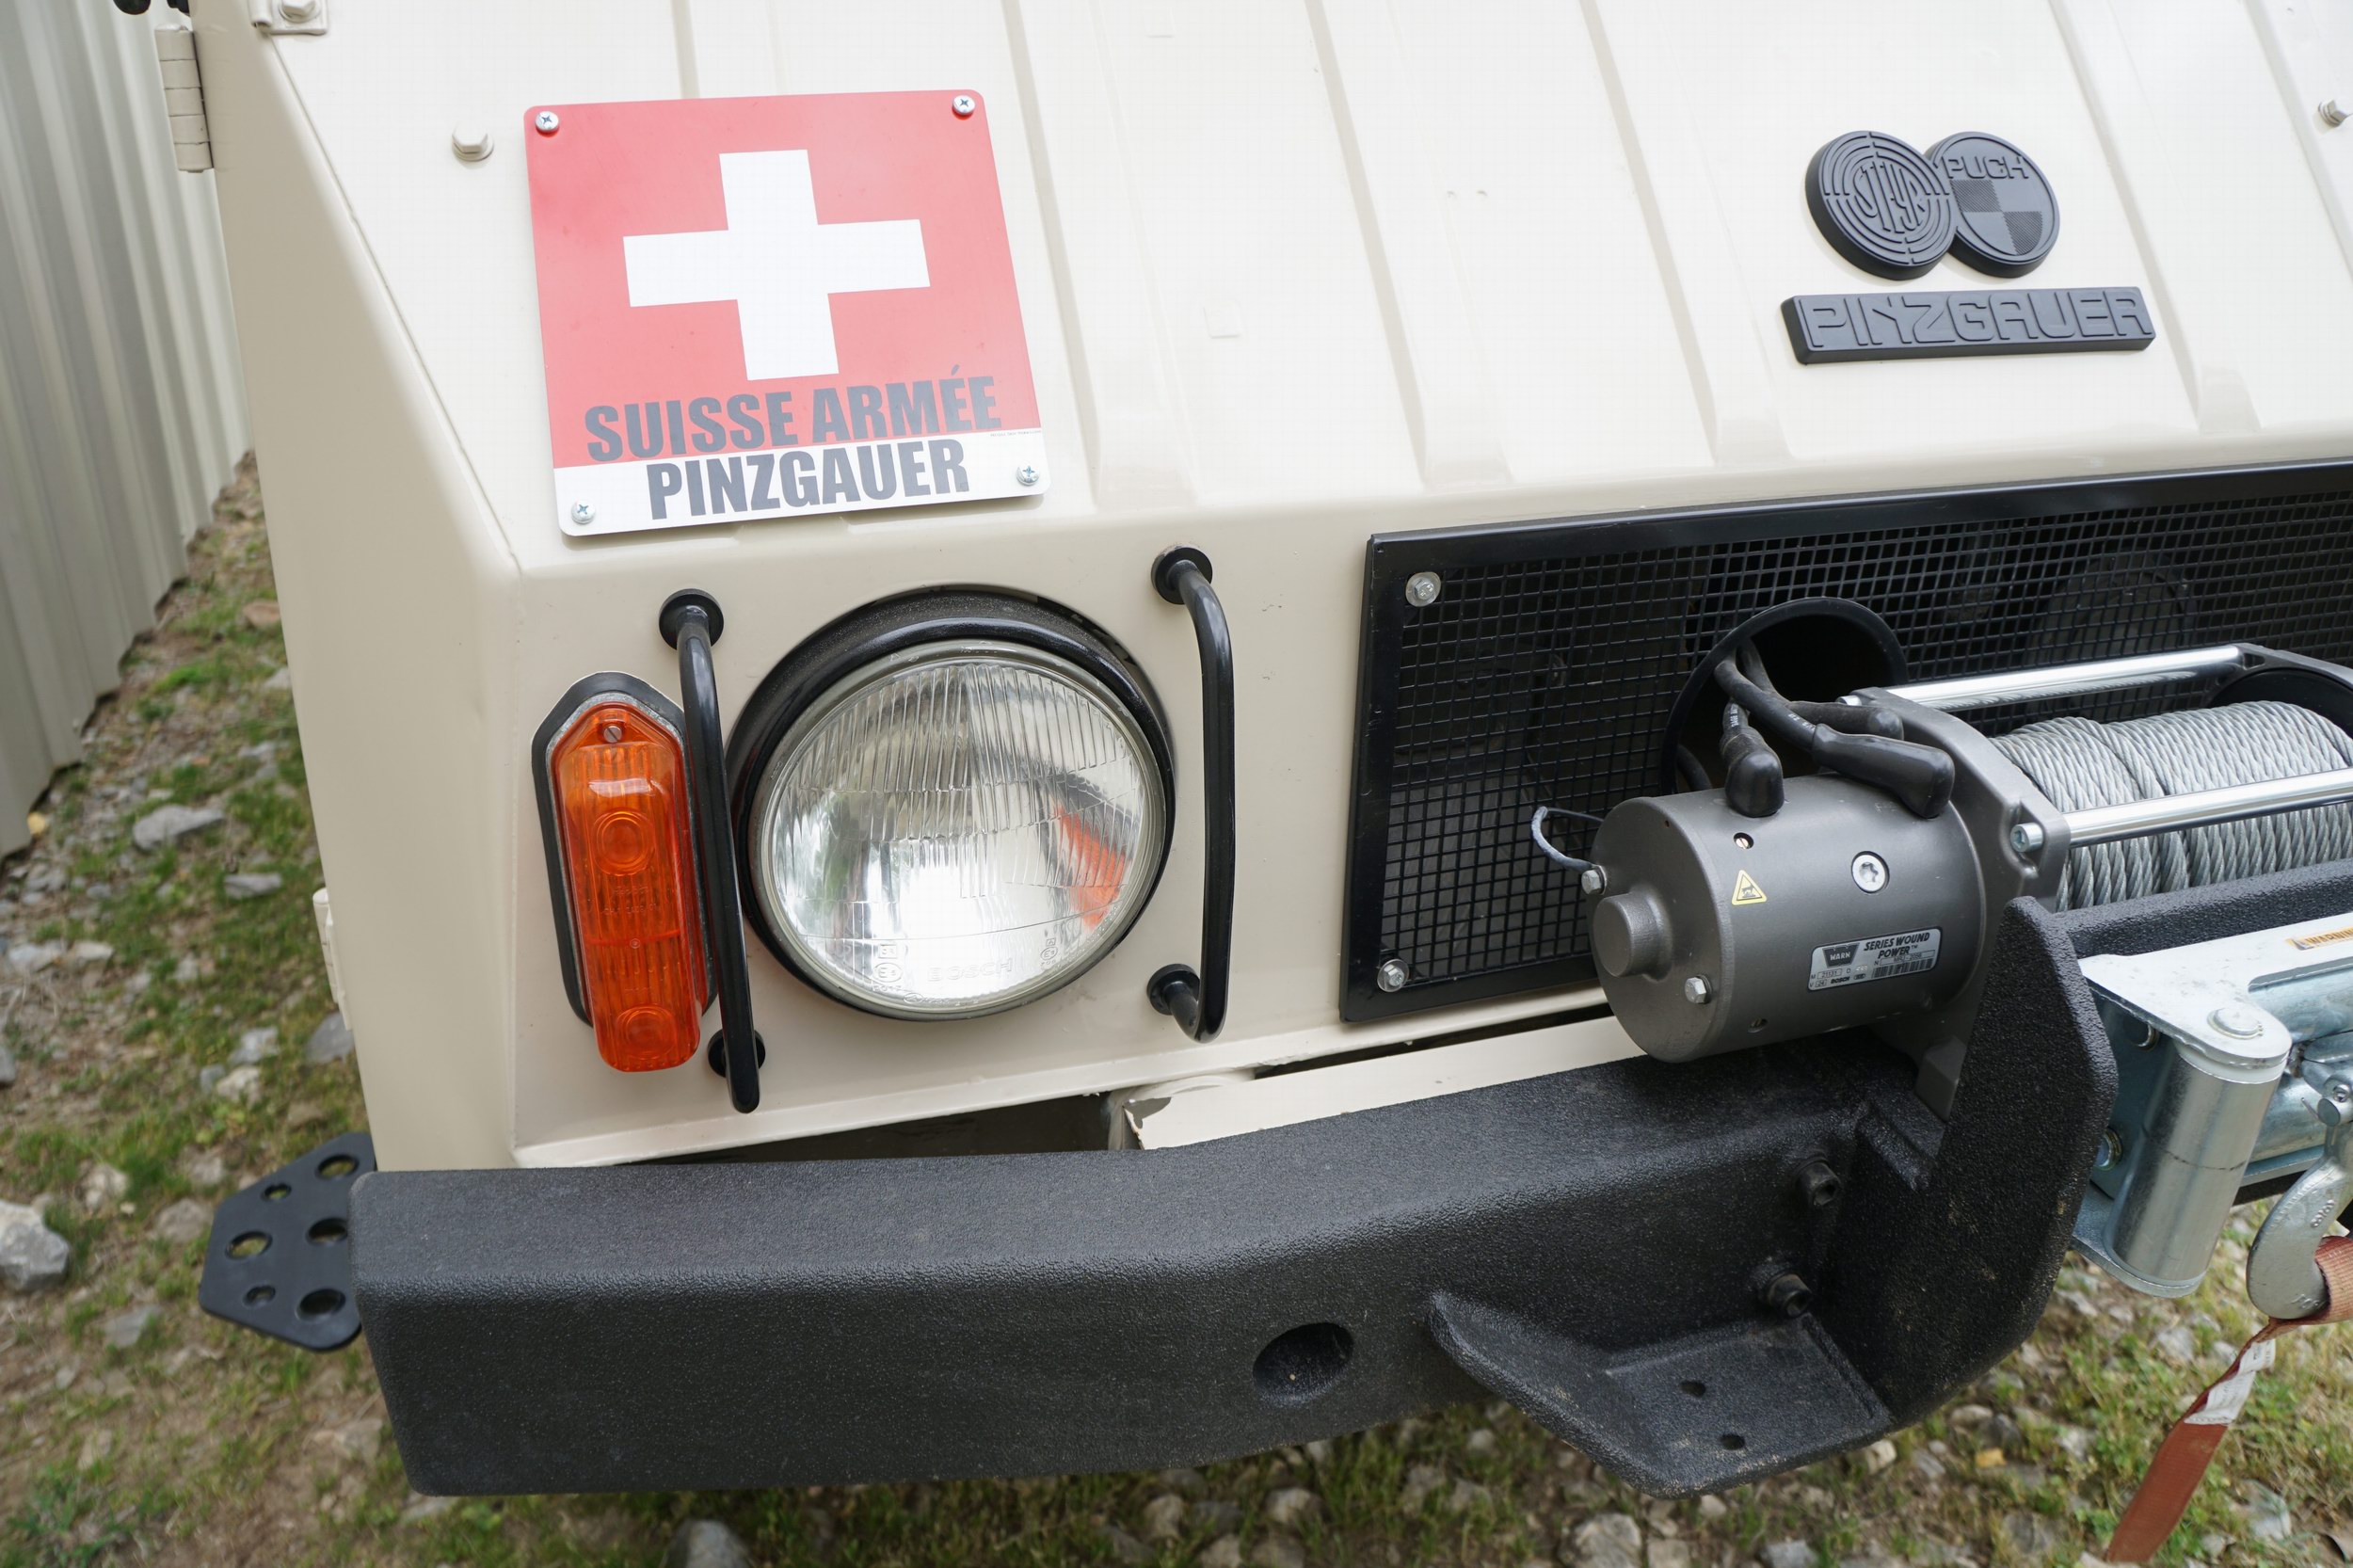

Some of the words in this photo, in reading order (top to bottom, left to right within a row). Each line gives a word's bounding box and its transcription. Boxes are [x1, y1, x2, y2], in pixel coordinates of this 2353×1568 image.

[1942, 155, 2029, 180] PUCH
[1799, 290, 2154, 347] PINZGAUER
[584, 391, 798, 462] SUISSE
[811, 364, 1001, 446] ARMÉE
[646, 439, 969, 520] PINZGAUER
[1864, 937, 1895, 952] SERIES
[1896, 932, 1930, 946] WOUND
[1830, 951, 1851, 961] WARN
[927, 957, 1014, 982] BOSCH
